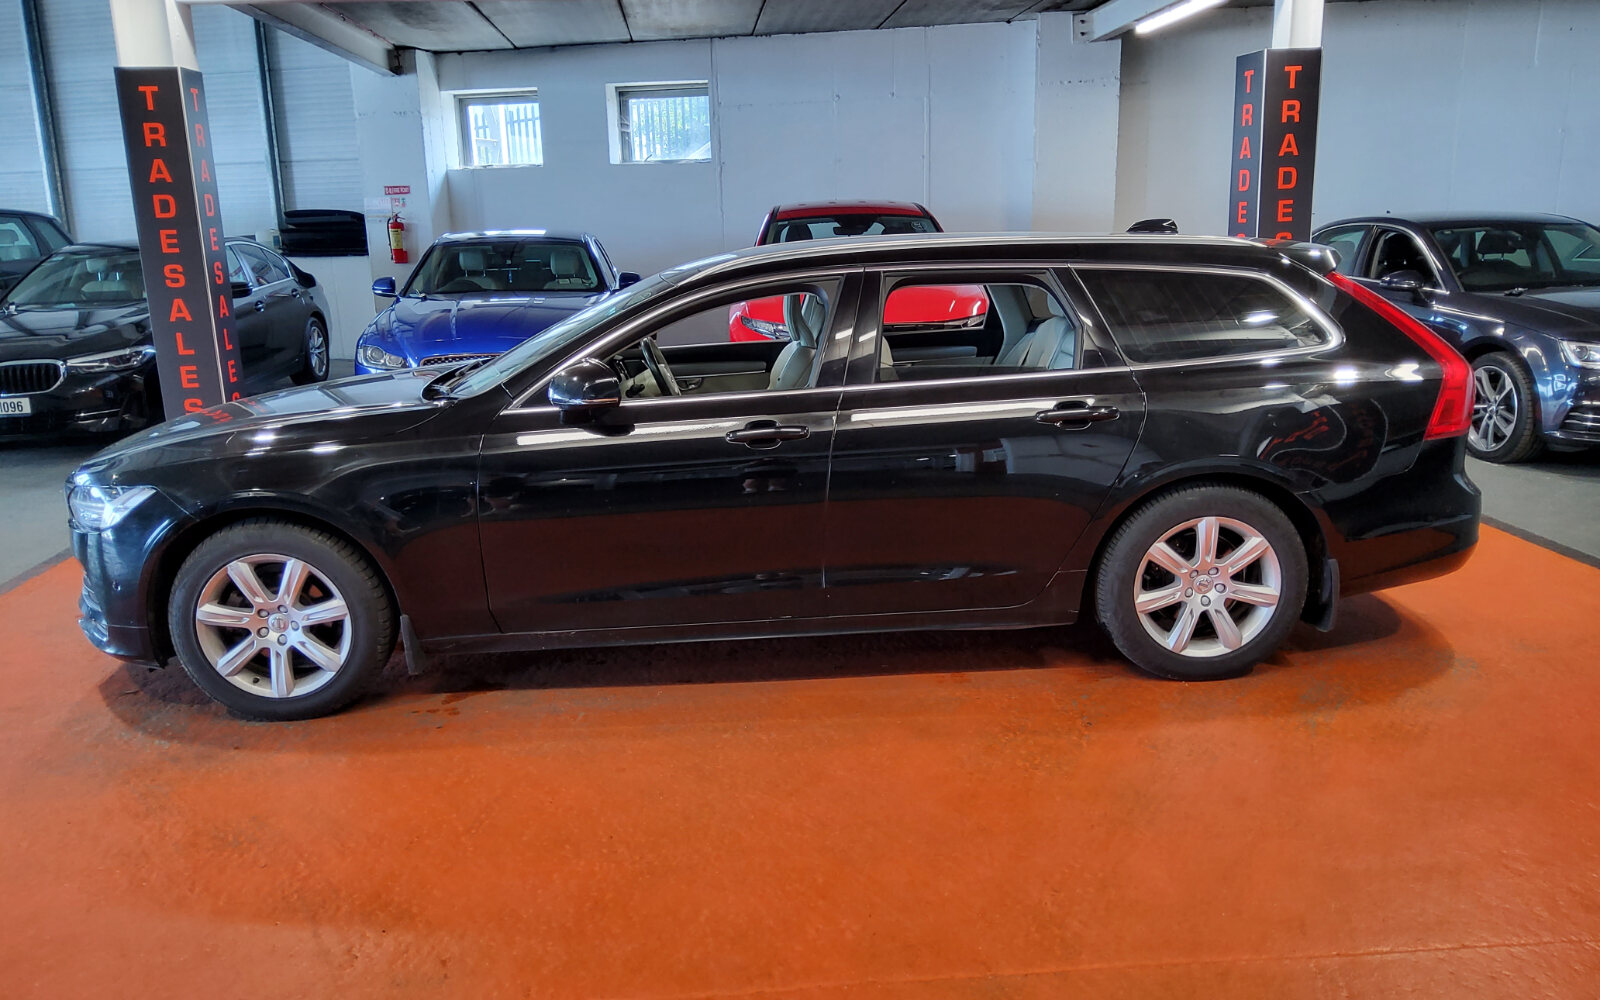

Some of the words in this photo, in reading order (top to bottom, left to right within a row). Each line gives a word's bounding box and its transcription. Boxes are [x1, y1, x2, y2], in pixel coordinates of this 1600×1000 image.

[1237, 69, 1255, 238] TRADE
[138, 85, 203, 415] TRADESALES
[0, 401, 24, 413] 096
